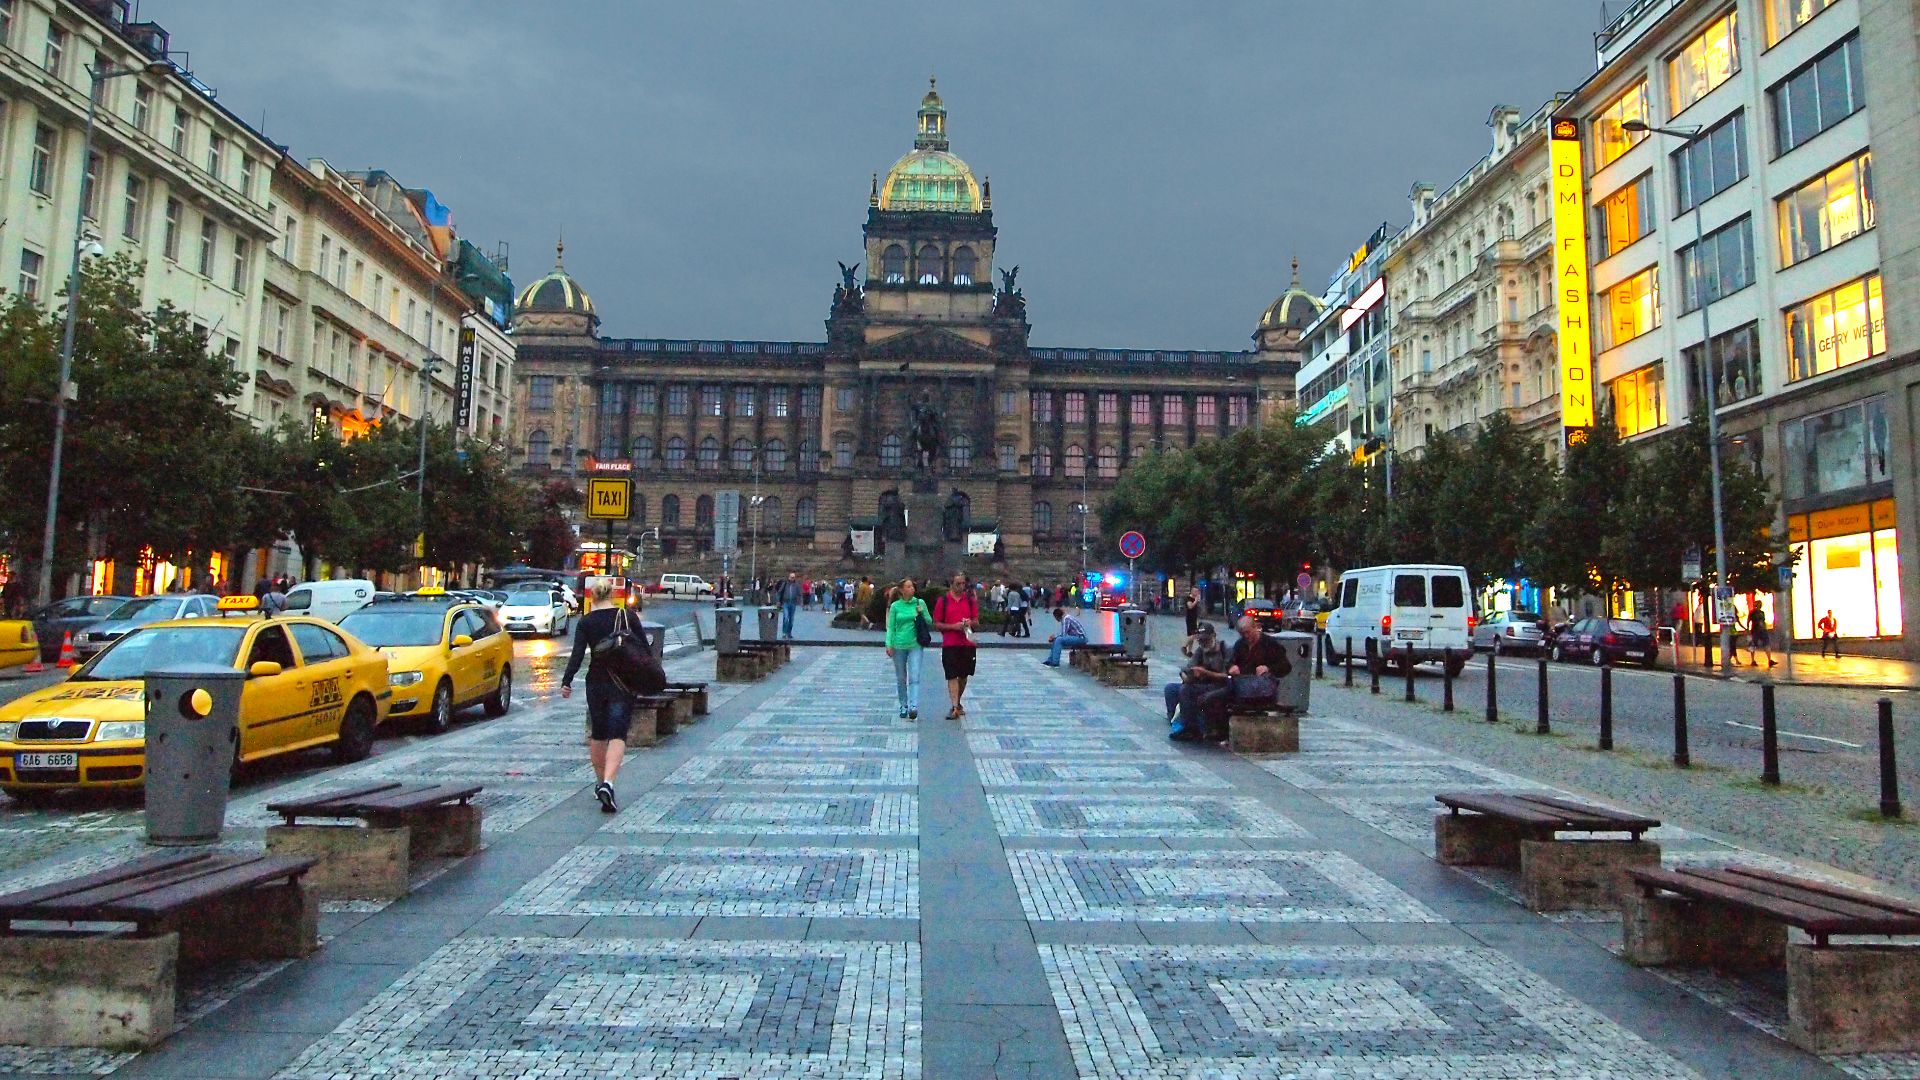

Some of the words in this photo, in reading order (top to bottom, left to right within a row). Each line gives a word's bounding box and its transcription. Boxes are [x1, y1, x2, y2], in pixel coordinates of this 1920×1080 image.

[1564, 238, 1585, 407] FASHION
[1818, 331, 1849, 353] GERRY
[459, 346, 472, 426] McDonald's
[610, 463, 631, 471] PLACE
[597, 490, 622, 506] TAXI
[310, 676, 342, 707] AAA
[22, 754, 41, 766] 6A6
